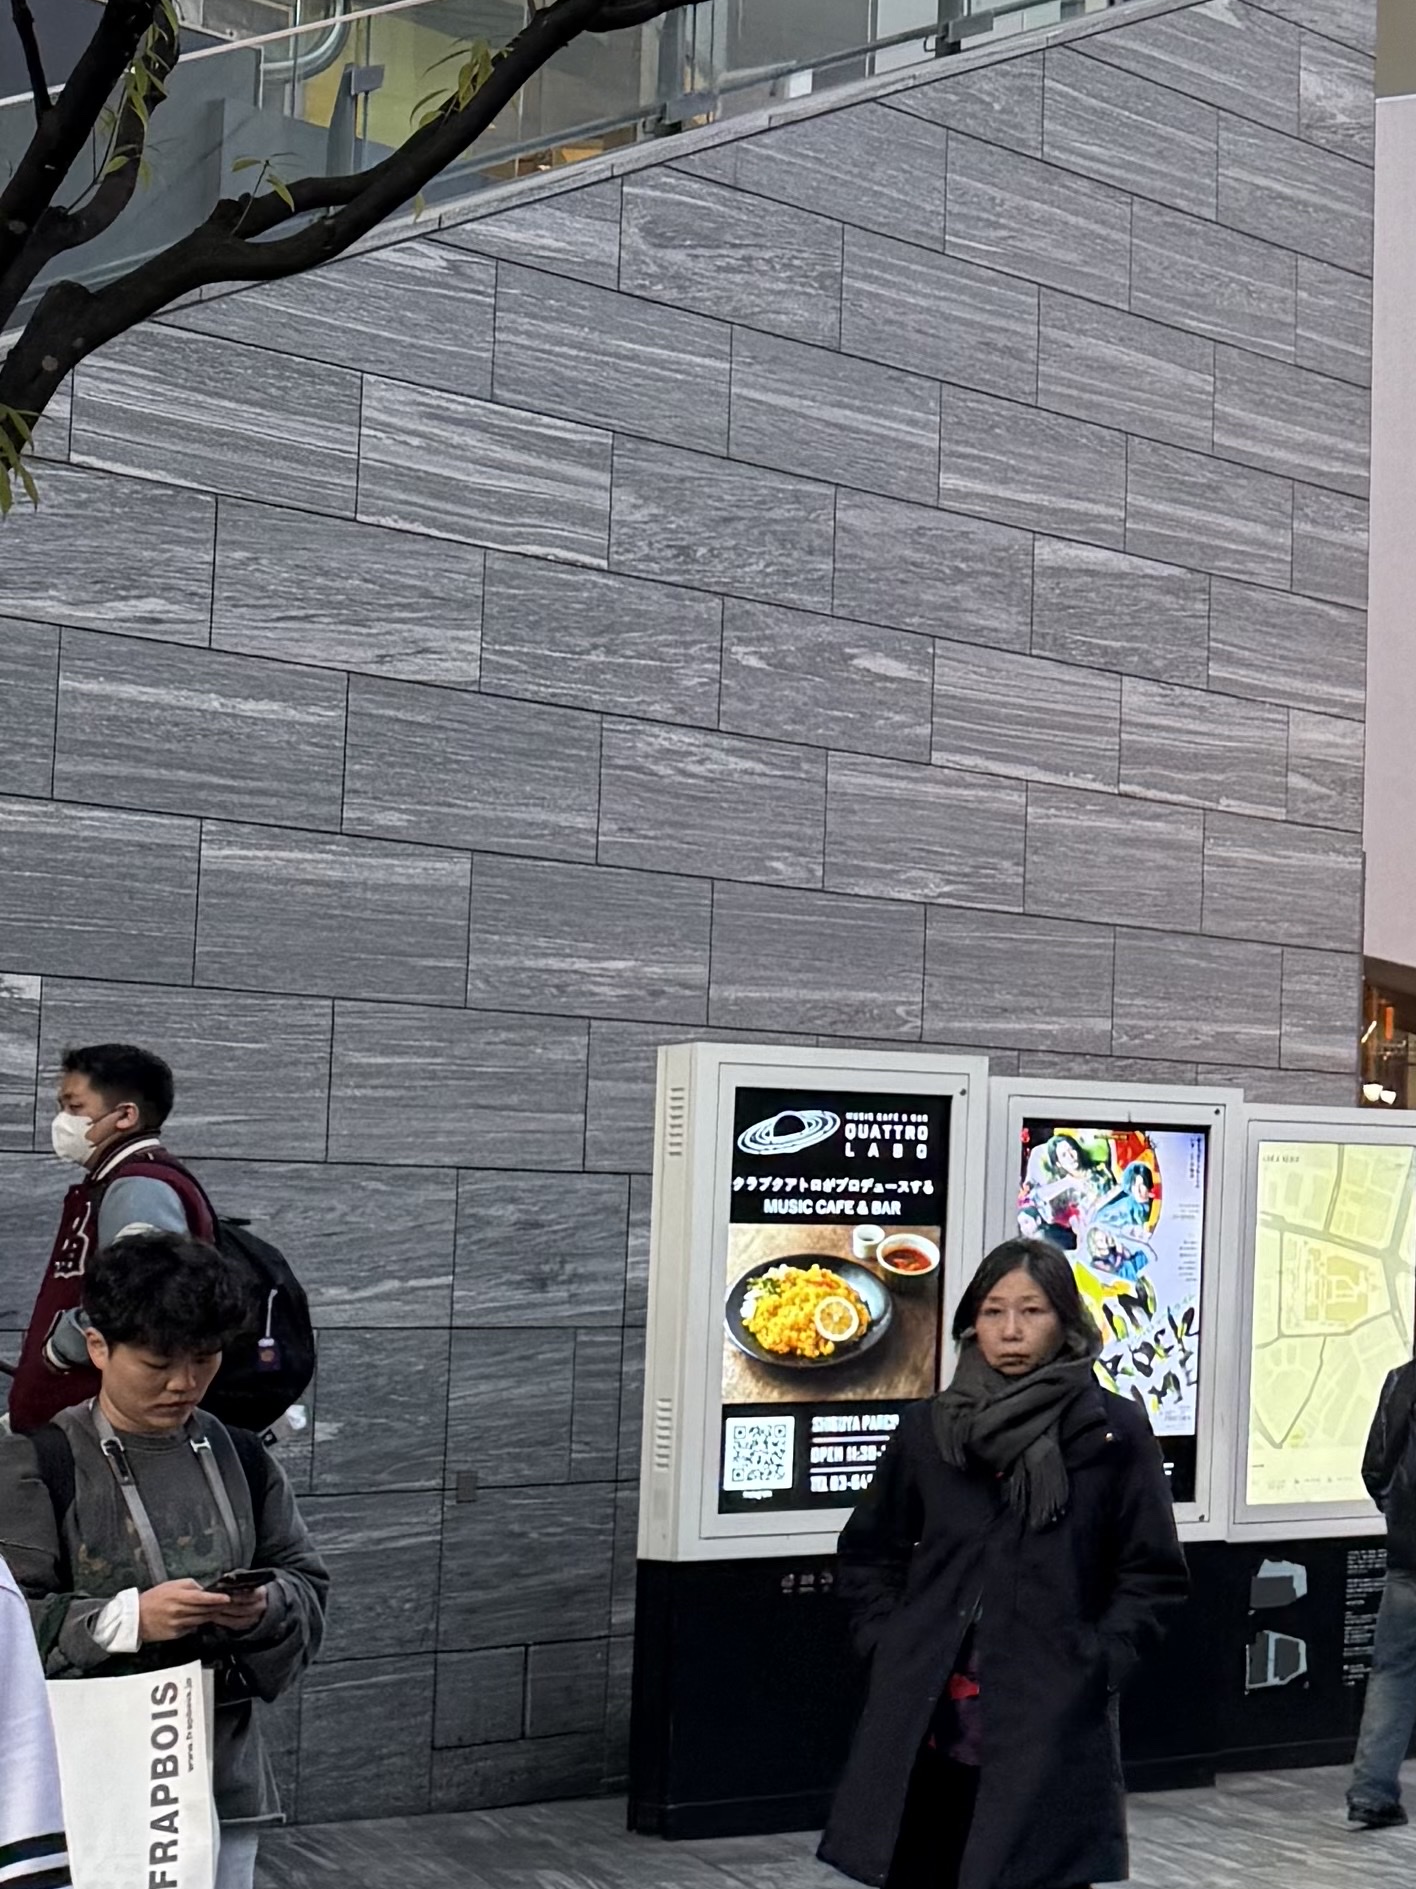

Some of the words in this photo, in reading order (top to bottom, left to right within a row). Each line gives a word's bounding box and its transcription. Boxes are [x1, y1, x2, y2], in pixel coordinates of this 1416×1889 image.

[845, 1123, 928, 1140] QUATTRO
[763, 1198, 813, 1214] MUSIC
[815, 1200, 855, 1215] CAFE
[856, 1201, 869, 1215] &
[871, 1201, 901, 1216] BAR
[149, 1681, 179, 1889] FRAPBOIS
